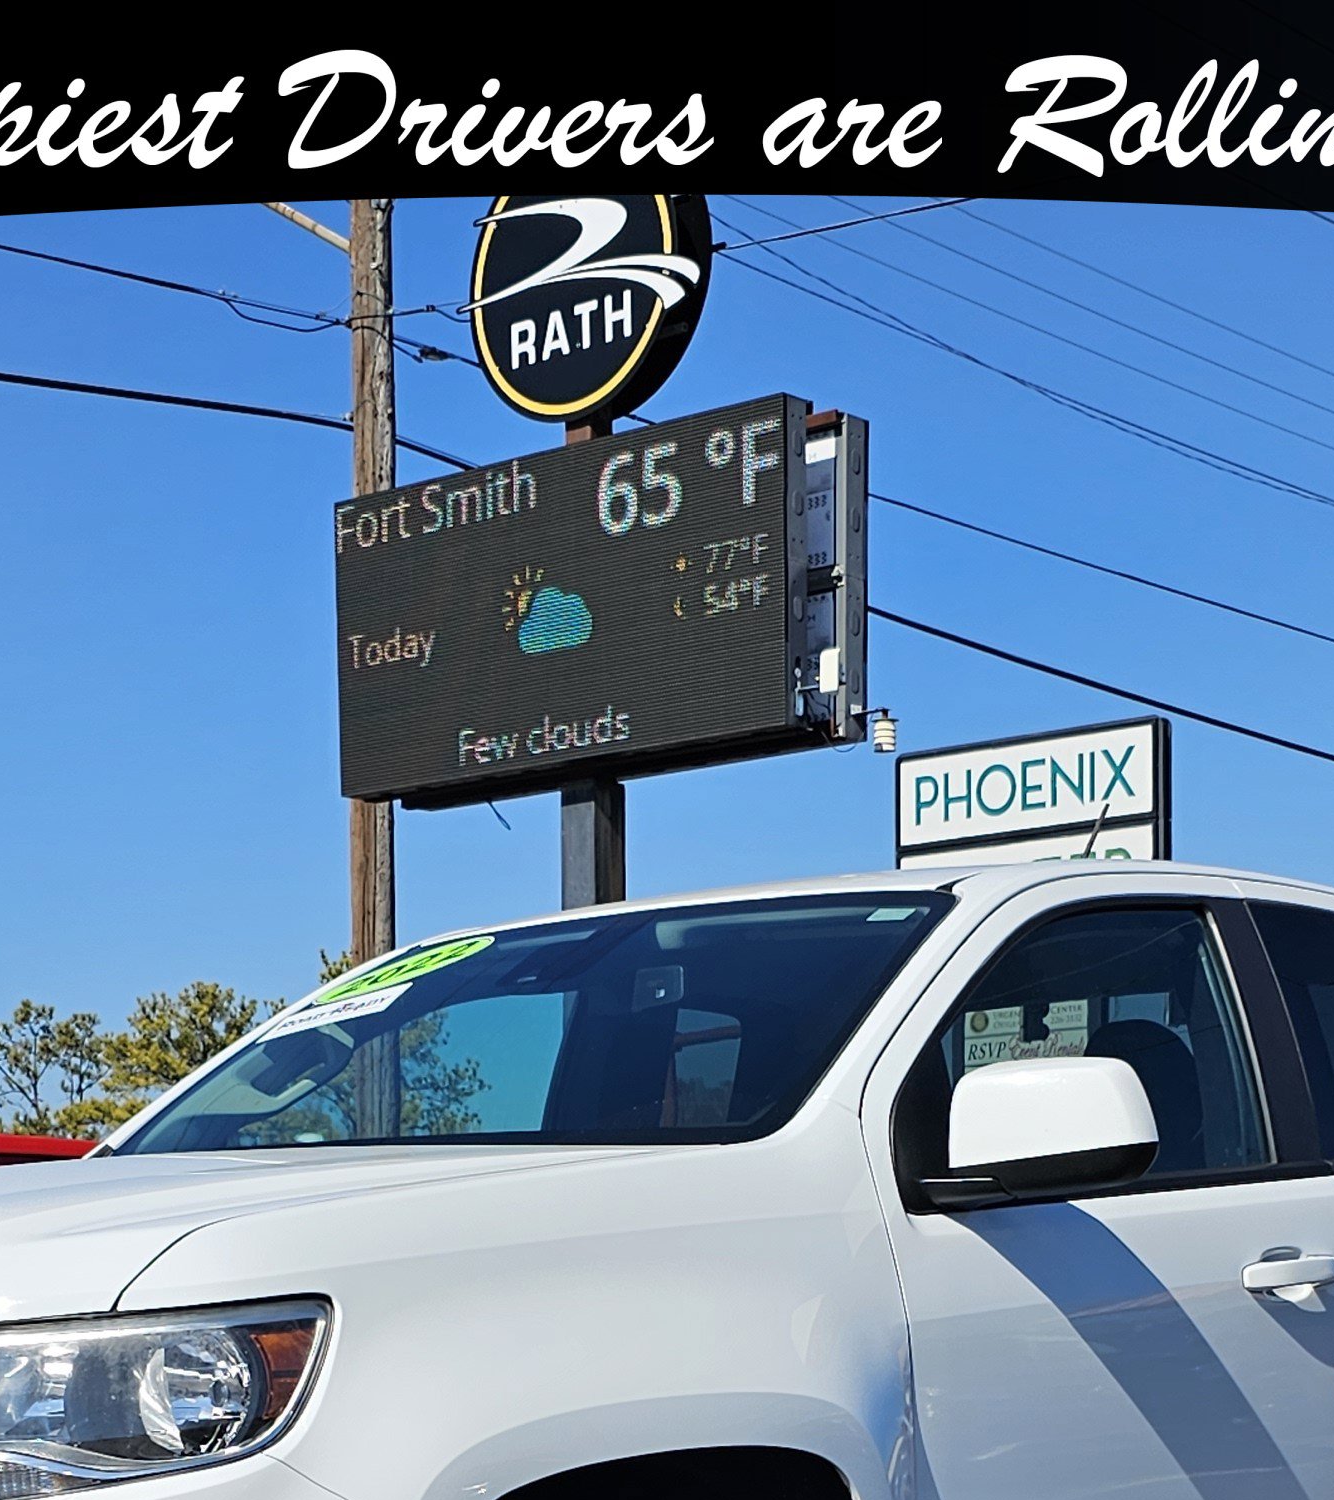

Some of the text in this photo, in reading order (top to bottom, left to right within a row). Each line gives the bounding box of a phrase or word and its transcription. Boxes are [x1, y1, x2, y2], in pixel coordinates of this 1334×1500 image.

[509, 289, 633, 370] RATH
[337, 459, 536, 554] Fort Smith
[598, 439, 682, 538] 65
[349, 627, 436, 668] Today
[458, 704, 631, 767] Few clouds
[914, 744, 1137, 827] PHOENIX
[328, 940, 481, 1000] 2022
[968, 1041, 1007, 1061] RSVP
